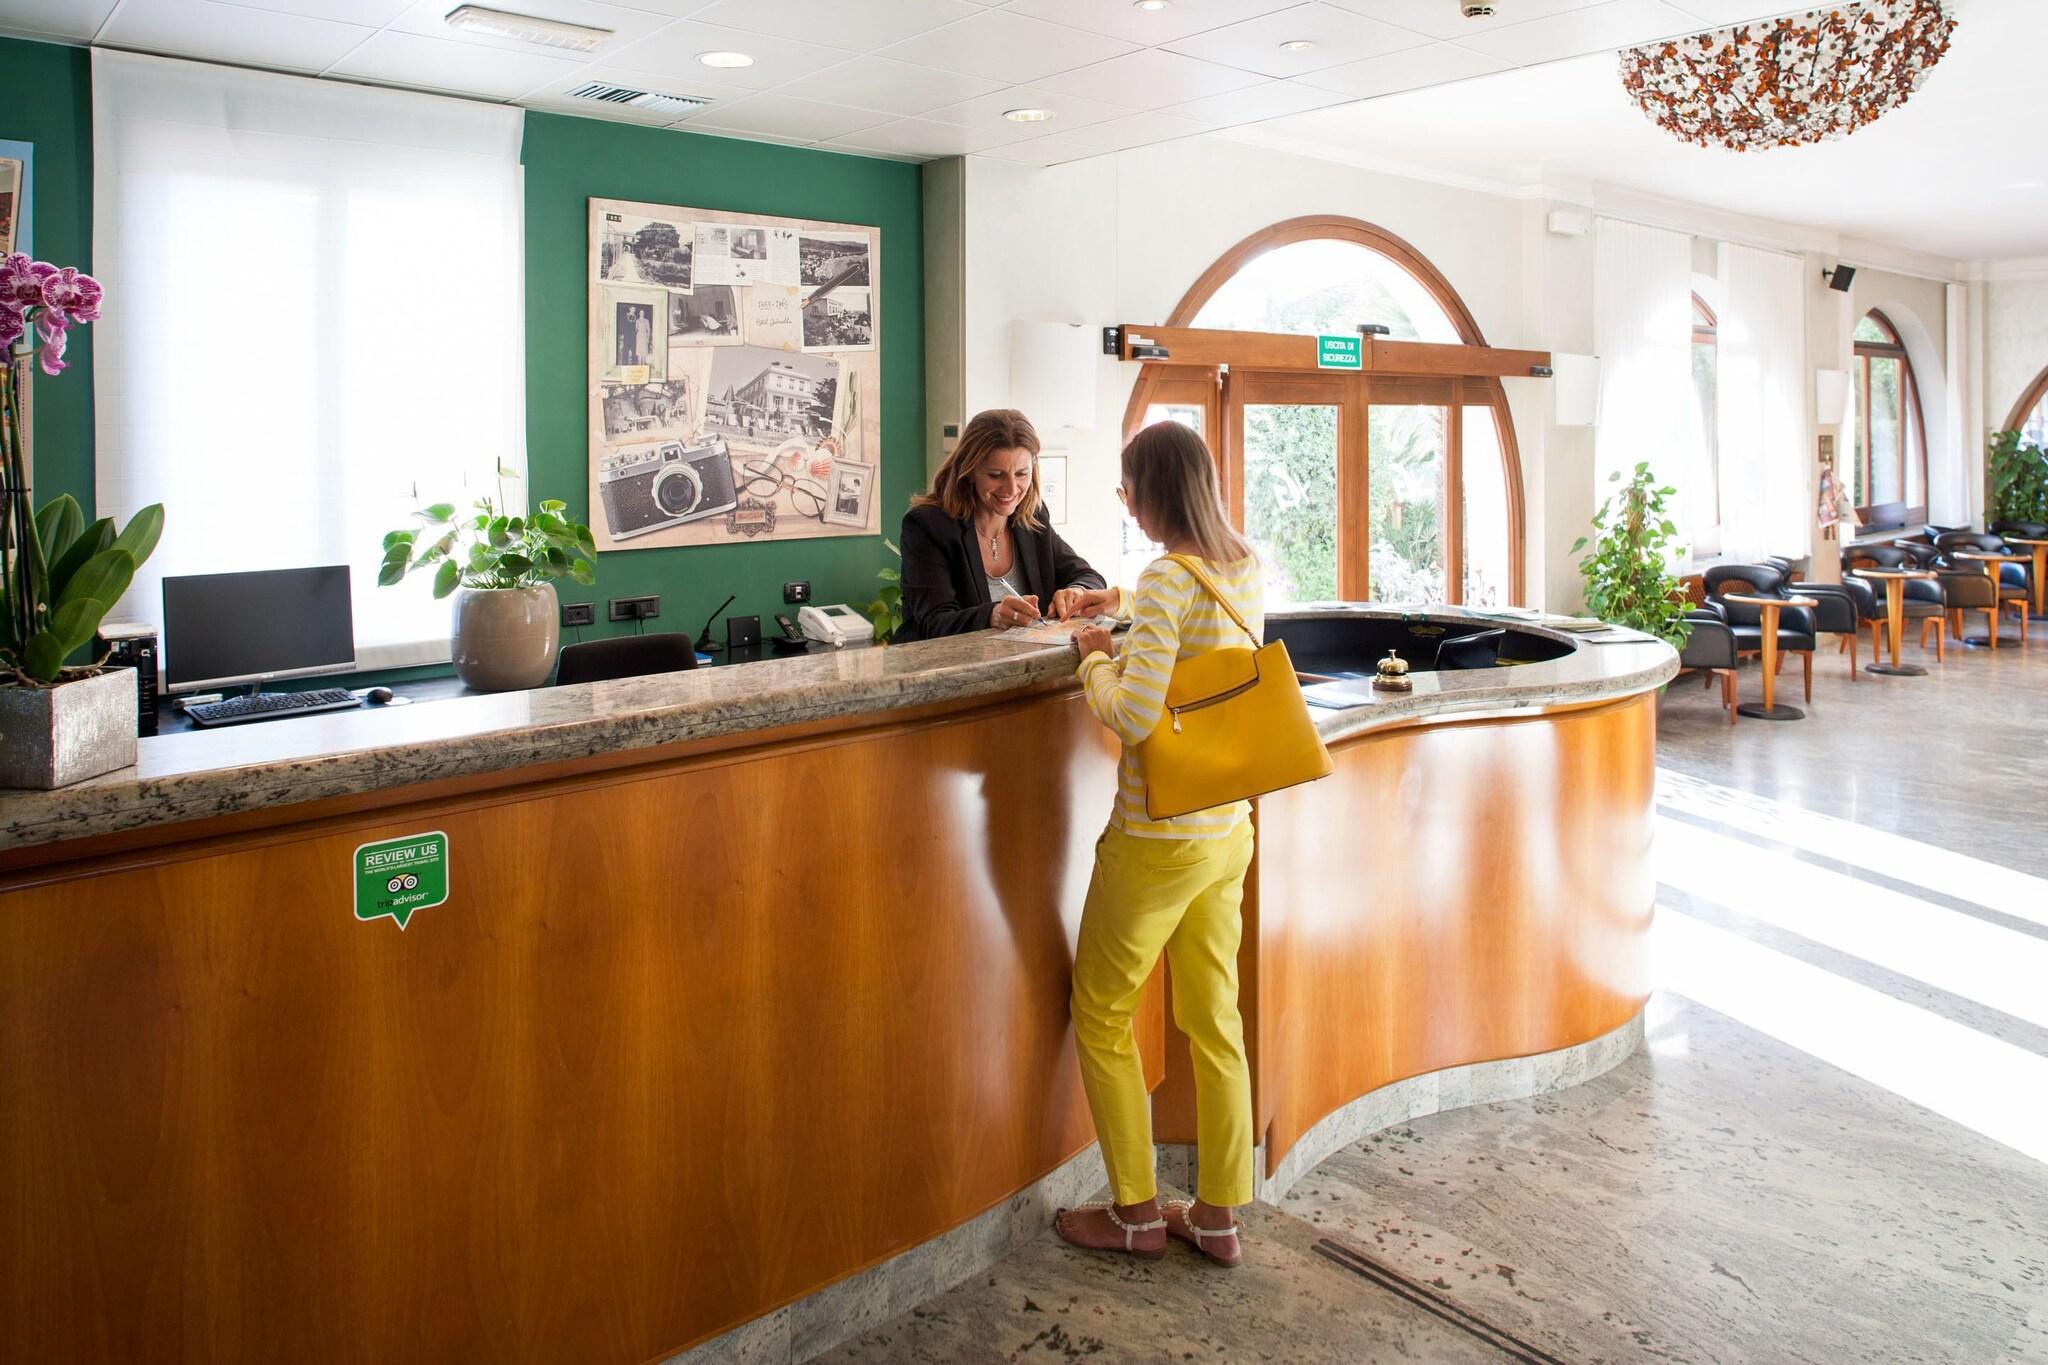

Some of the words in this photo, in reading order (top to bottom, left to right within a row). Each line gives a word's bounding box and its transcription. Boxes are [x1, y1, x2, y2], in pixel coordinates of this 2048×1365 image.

[1324, 340, 1347, 350] USCITA
[1347, 341, 1354, 351] DI
[1322, 353, 1357, 363] SICUREZZA
[365, 848, 416, 867] REVIEW
[421, 844, 438, 856] US
[377, 892, 426, 909] tripadvisor
